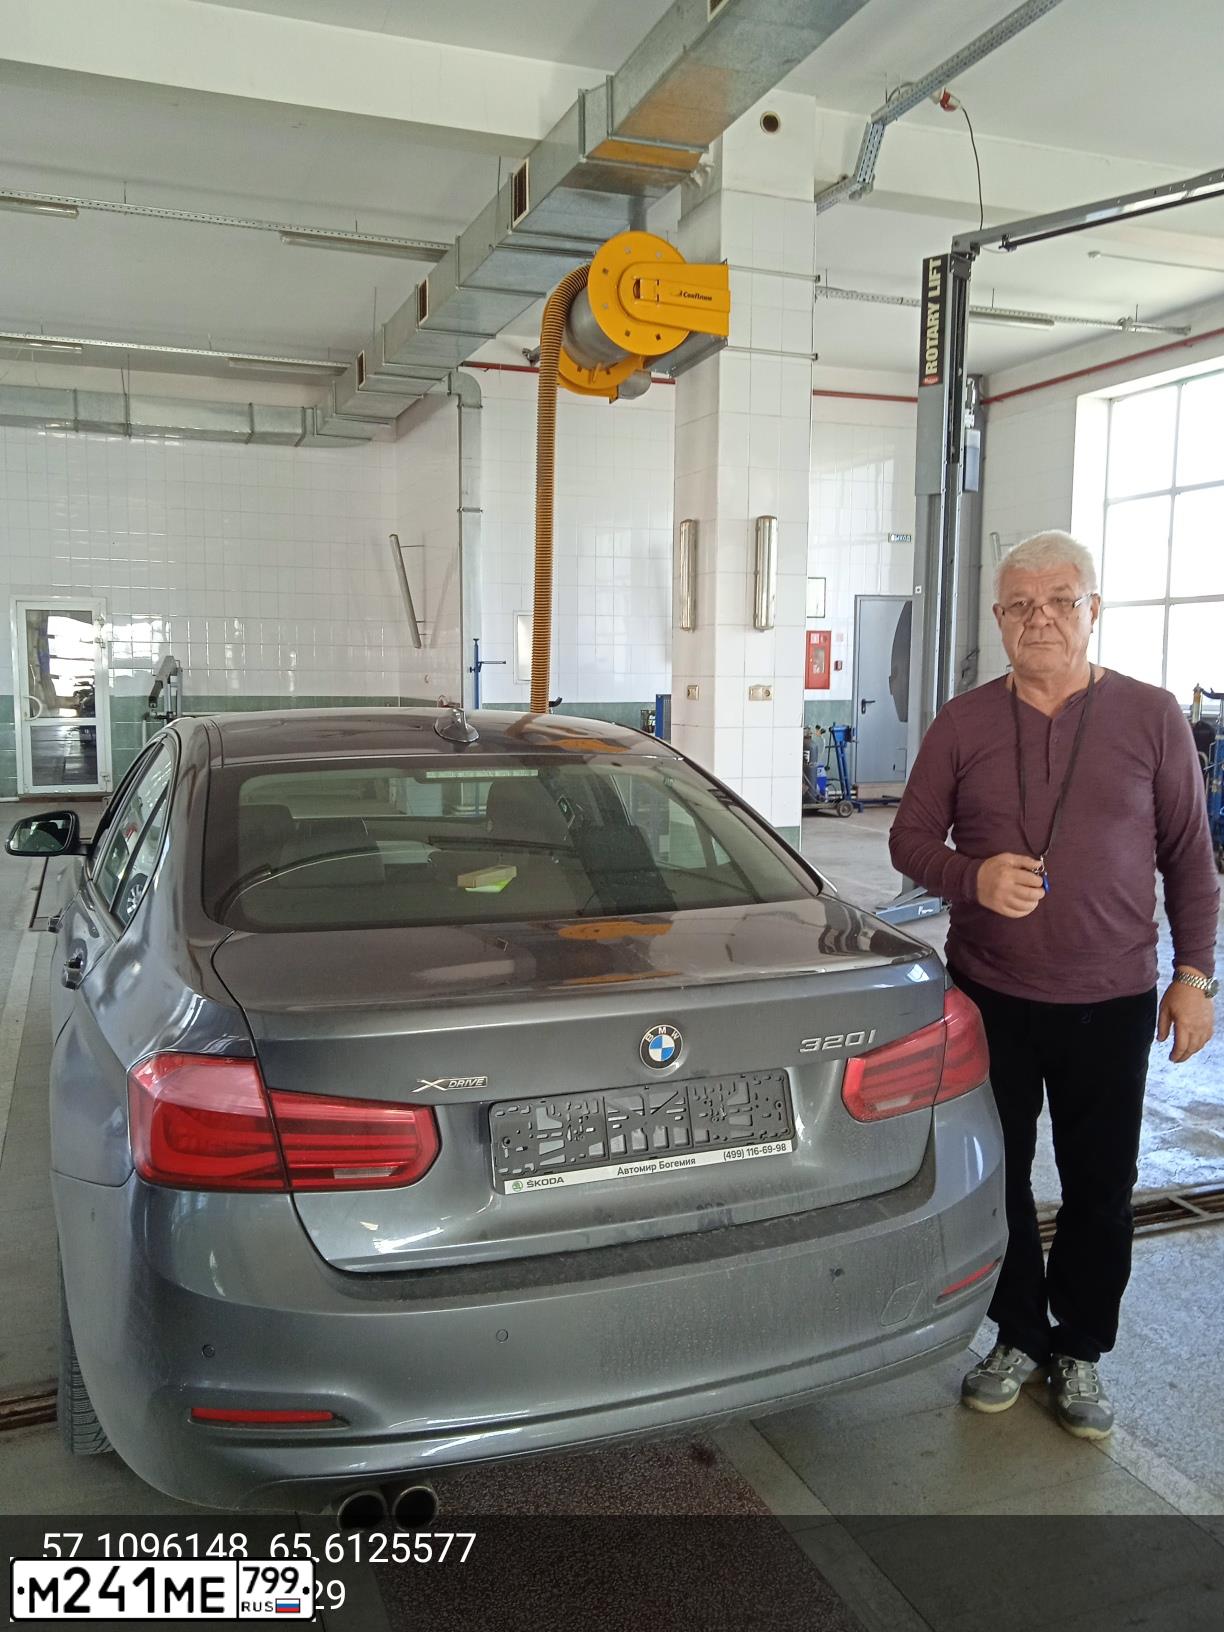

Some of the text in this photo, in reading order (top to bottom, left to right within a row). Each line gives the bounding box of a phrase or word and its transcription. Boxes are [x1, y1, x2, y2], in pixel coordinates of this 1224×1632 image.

[928, 258, 942, 298] LIFT
[925, 302, 940, 375] ROTARY
[645, 1026, 680, 1042] BMW
[723, 1143, 787, 1162] (499) 116-69-98
[617, 1158, 696, 1176] Автомир Богемия
[526, 1176, 565, 1188] ŠKODA
